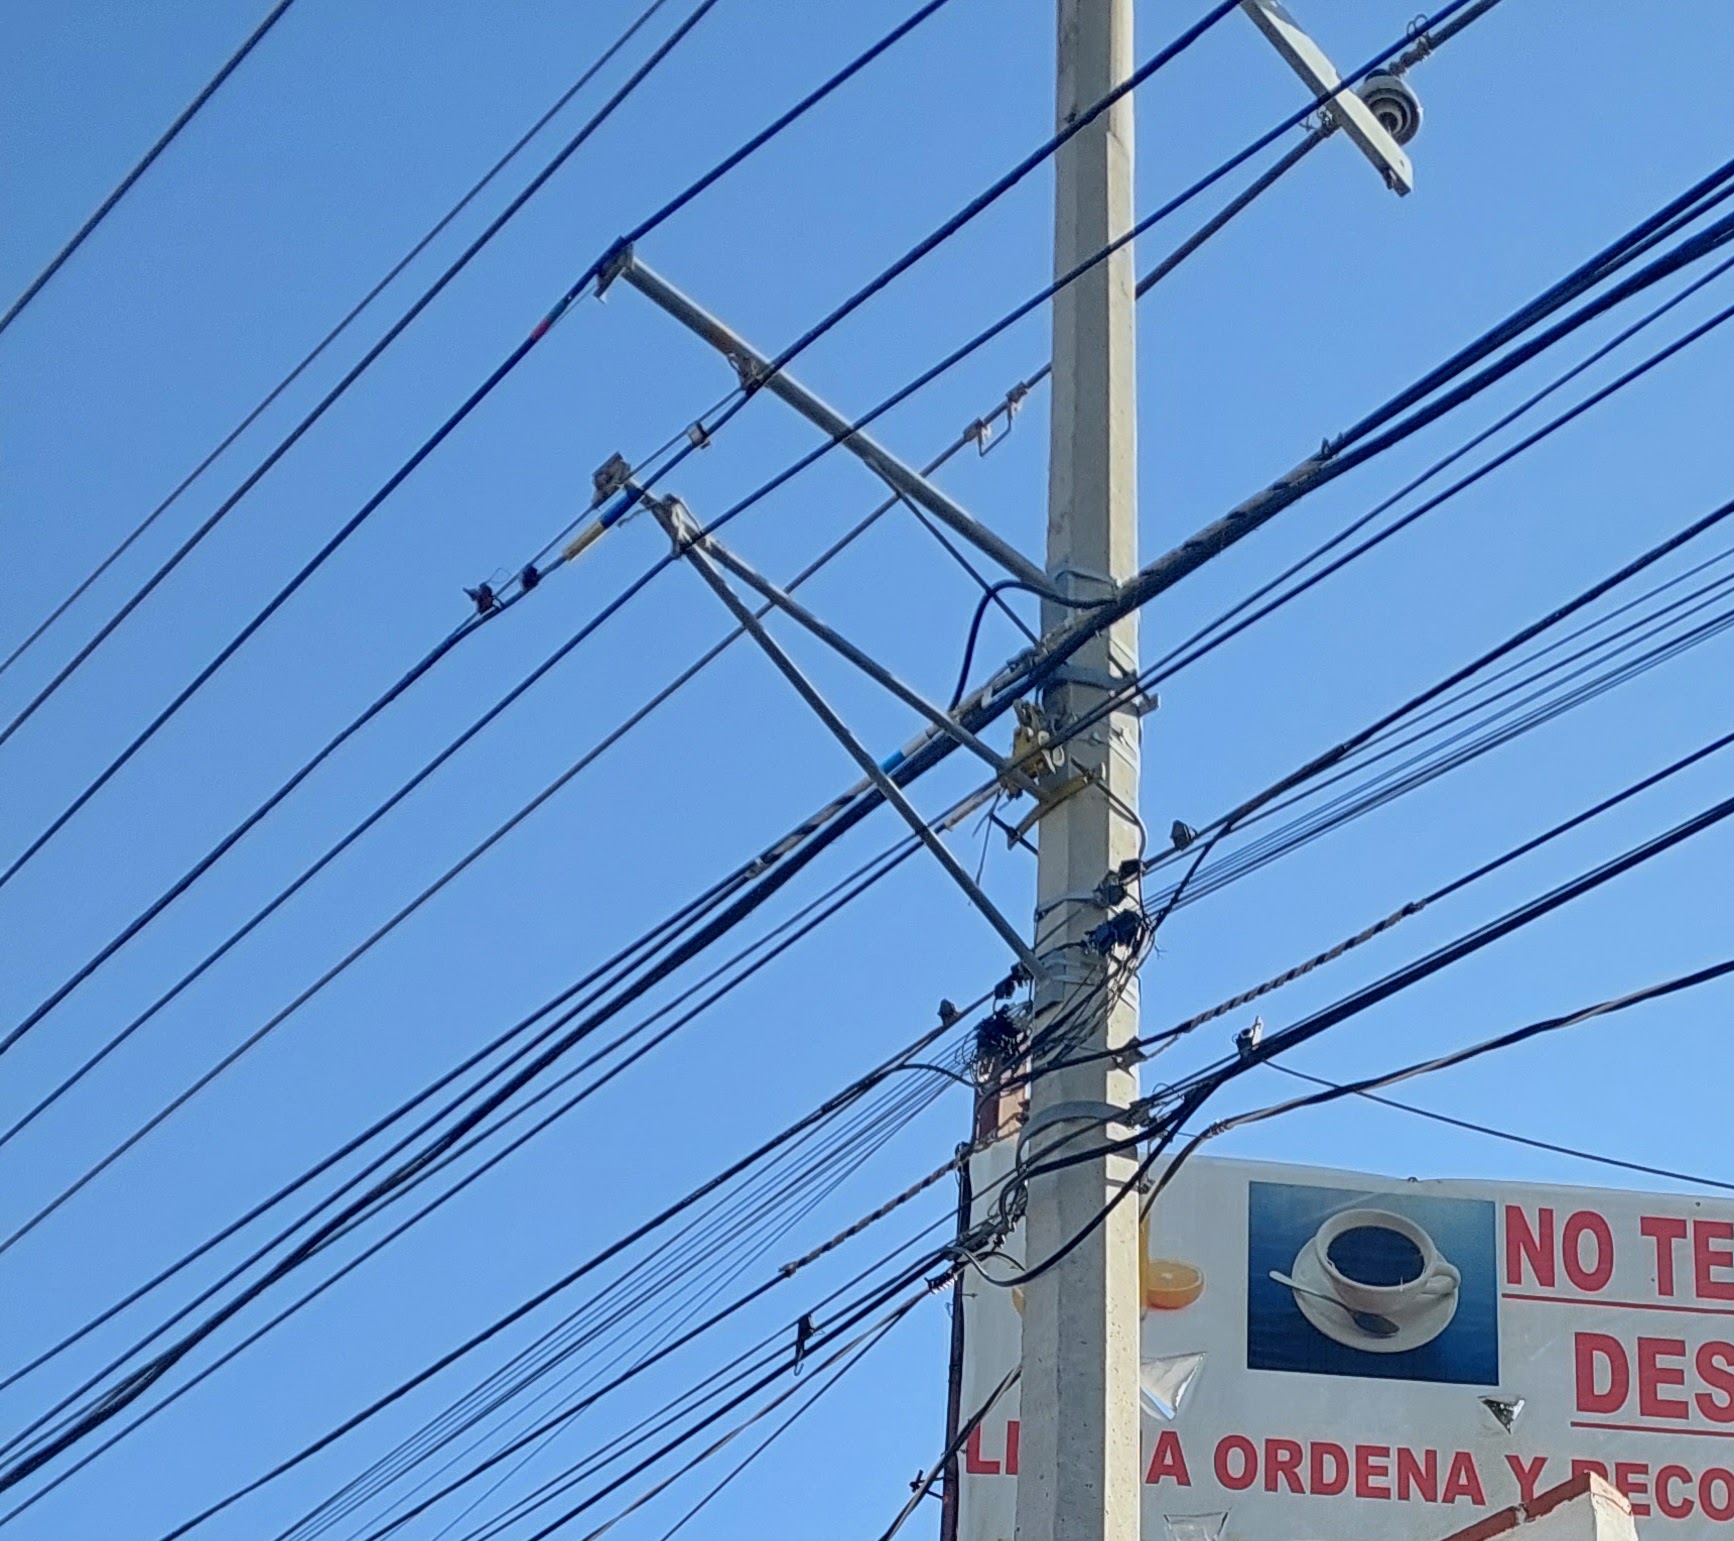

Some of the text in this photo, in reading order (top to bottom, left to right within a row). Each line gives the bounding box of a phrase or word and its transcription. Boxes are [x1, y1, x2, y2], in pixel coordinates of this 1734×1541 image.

[1504, 1204, 1614, 1293] NO
[1213, 1433, 1488, 1507] ORDENA
[1504, 1454, 1549, 1504] Y
